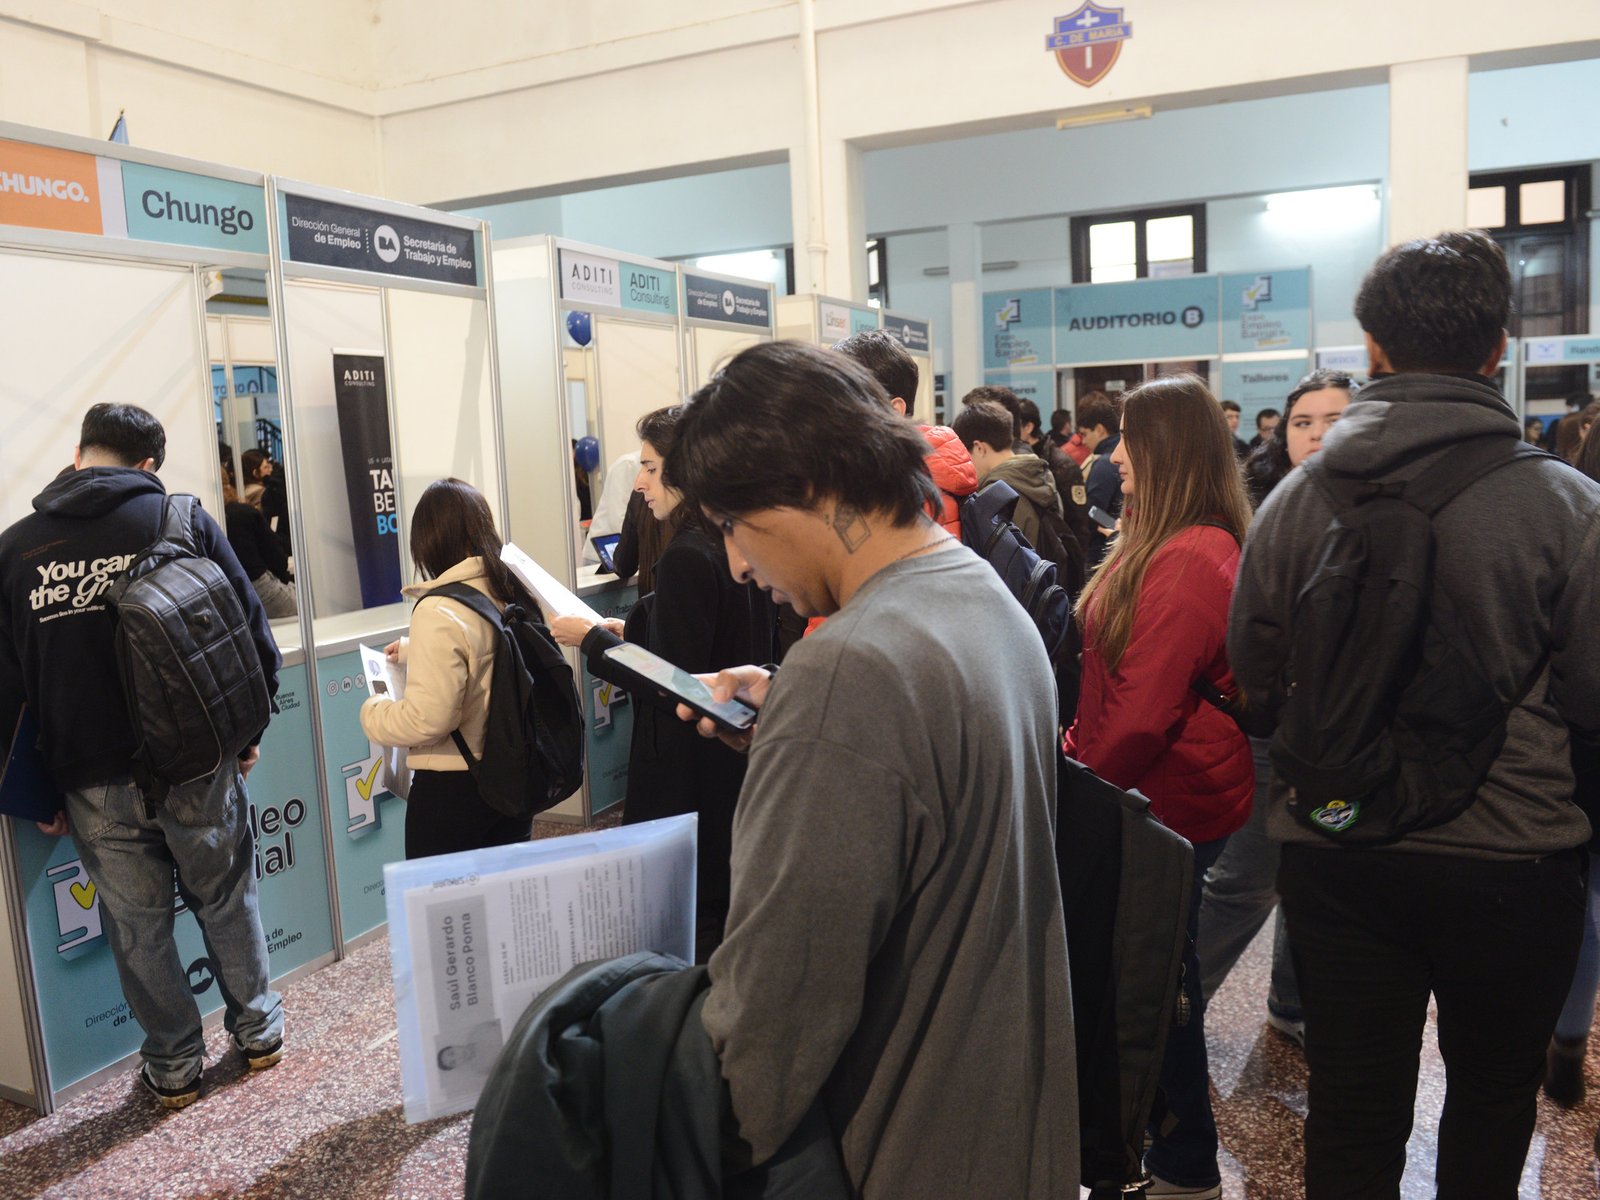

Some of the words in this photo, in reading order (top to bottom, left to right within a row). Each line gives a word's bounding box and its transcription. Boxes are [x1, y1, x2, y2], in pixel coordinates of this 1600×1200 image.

[142, 189, 254, 235] Chungo
[292, 217, 329, 232] Dirección
[331, 223, 360, 238] General
[315, 232, 326, 244] de
[328, 235, 361, 250] Empleo
[403, 236, 445, 253] Secretaría
[446, 244, 457, 254] de
[404, 249, 435, 265] Trabajo
[436, 255, 442, 266] y
[443, 257, 472, 270] Empleo
[572, 263, 612, 285] ADITI
[630, 272, 660, 291] ADITI
[571, 281, 613, 296] CONSULTING
[630, 288, 670, 309] Consulting
[1069, 311, 1176, 331] AUDITORIO
[344, 369, 374, 381] ADITI
[1242, 374, 1289, 383] Talleres
[369, 469, 394, 490] TA
[373, 491, 396, 513] BE
[37, 560, 86, 585] You
[29, 583, 70, 611] the
[281, 701, 300, 712] Ciudad
[249, 797, 305, 840] leo
[267, 931, 302, 954] Empleo
[271, 928, 283, 940] de
[462, 912, 474, 954] Poma
[441, 915, 458, 976] Gerardo
[465, 956, 479, 1006] Blanco
[446, 978, 461, 1011] Saúl
[113, 1015, 127, 1027] de
